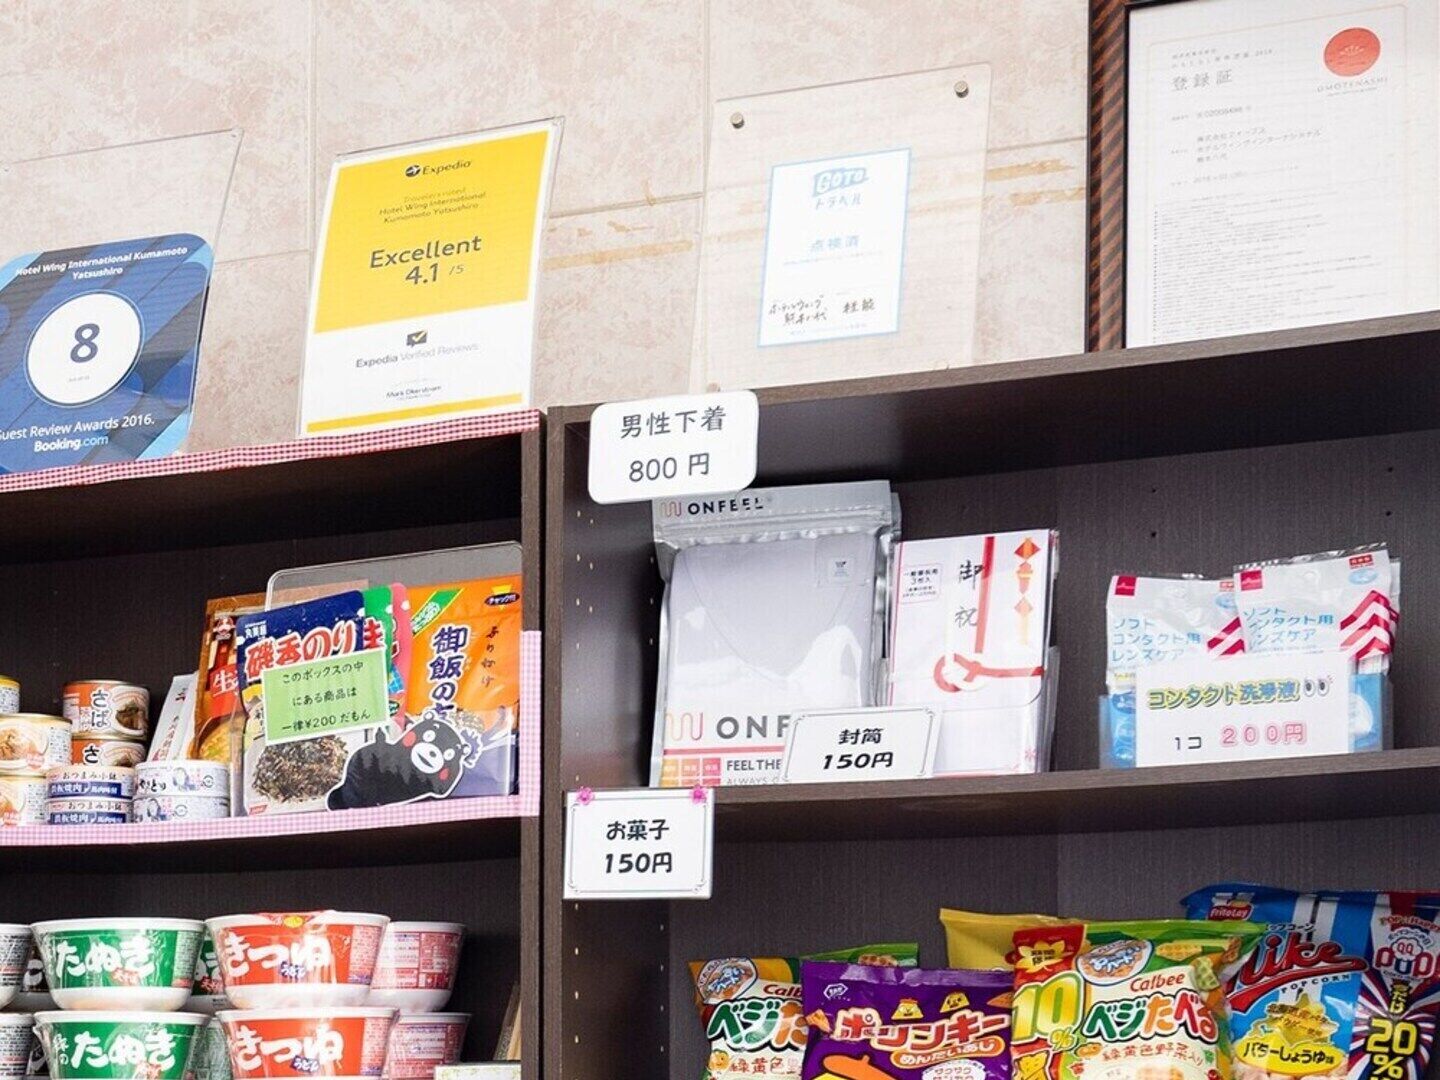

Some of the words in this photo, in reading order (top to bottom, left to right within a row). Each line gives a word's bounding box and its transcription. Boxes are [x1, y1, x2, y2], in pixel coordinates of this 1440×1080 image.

[1172, 69, 1233, 91] 登録証
[422, 160, 472, 176] Expedia
[379, 206, 403, 216] Hotel
[405, 202, 428, 211] Wing
[429, 191, 487, 206] International
[815, 193, 861, 209] トラベル
[16, 263, 41, 276] Hotel
[42, 260, 67, 273] Wing
[68, 252, 132, 270] International
[133, 246, 188, 260] Kumamoto
[370, 235, 482, 269] Excellent
[72, 267, 123, 280] Yatsushiro
[405, 263, 440, 286] 4.1
[69, 323, 101, 363] 8
[356, 354, 398, 369] Expedia
[29, 422, 72, 438] Review
[73, 418, 119, 434] Awards
[621, 406, 727, 439] 男性下着
[33, 435, 109, 453] Booking.com
[1114, 632, 1201, 645] コンタクト用
[213, 668, 238, 696] 生
[283, 661, 364, 684] このボックスの中
[293, 688, 357, 706] にある商品は
[1147, 680, 1300, 710] コンタクト洗浄液
[91, 689, 110, 728] さば
[839, 728, 883, 746] 封筒
[1221, 721, 1307, 747] 200円
[726, 760, 755, 771] FEEL
[823, 751, 894, 770] 150円
[606, 819, 670, 841] お菓子
[605, 852, 673, 874] 150円
[56, 938, 156, 977] たぬき
[224, 932, 333, 977] きつね
[1130, 971, 1186, 992] Calbee
[1281, 974, 1351, 994] POPCORN
[840, 1012, 1006, 1051] ポリンキー
[70, 1029, 176, 1070] たぬき
[236, 1022, 344, 1071] きつね
